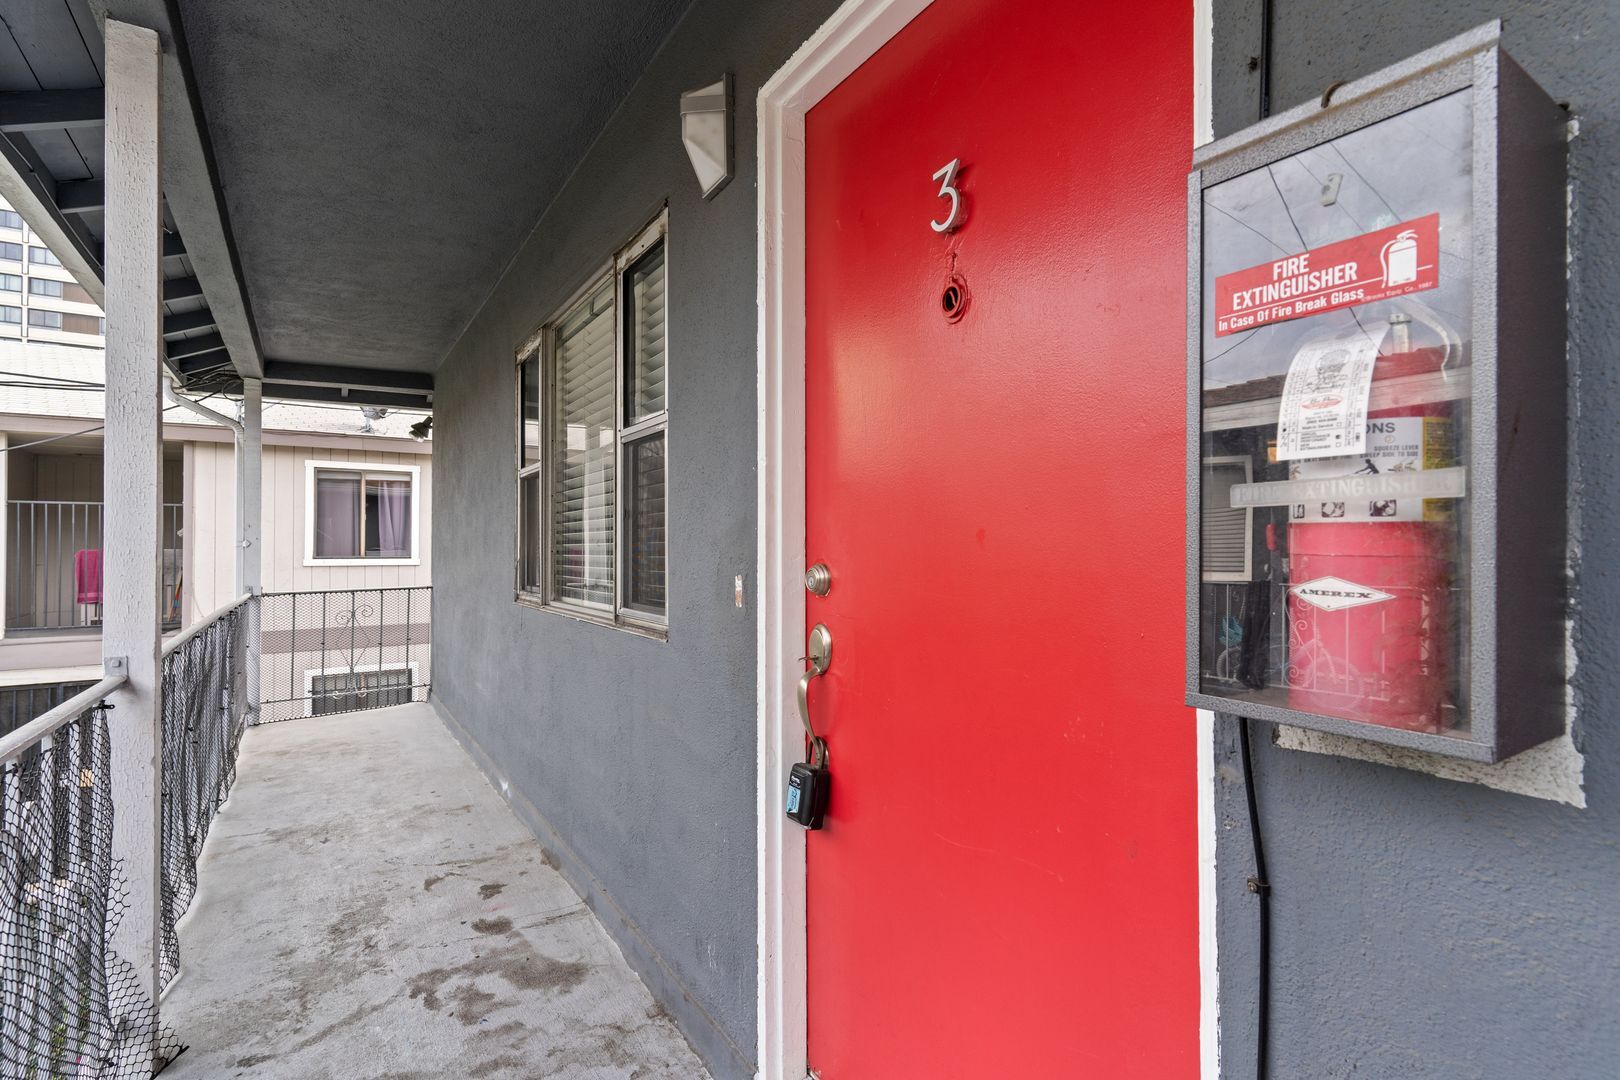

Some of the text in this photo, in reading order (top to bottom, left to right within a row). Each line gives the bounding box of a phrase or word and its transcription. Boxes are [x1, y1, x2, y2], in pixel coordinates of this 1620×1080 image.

[930, 158, 961, 233] 3
[1232, 261, 1358, 311] EXTINGUISHER
[1272, 254, 1310, 281] FIRE
[1218, 288, 1364, 331] In Case Of Fire Break Glass
[1299, 588, 1374, 599] AMEREX
